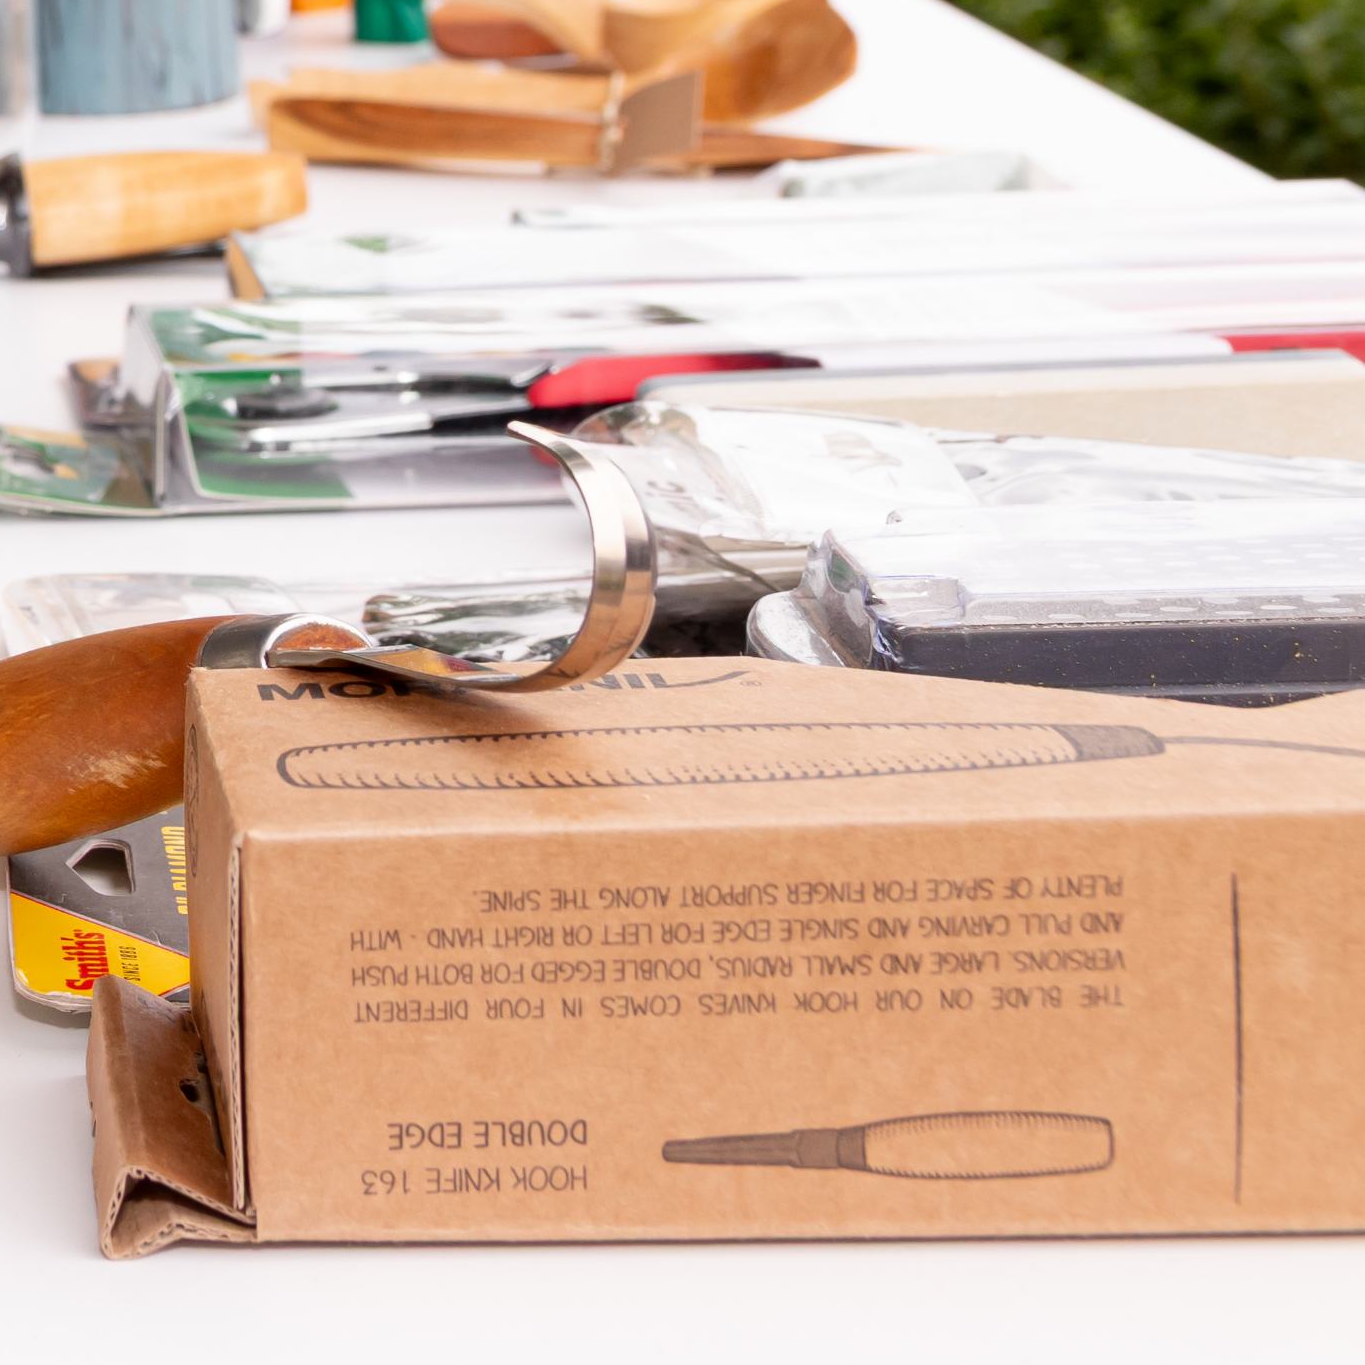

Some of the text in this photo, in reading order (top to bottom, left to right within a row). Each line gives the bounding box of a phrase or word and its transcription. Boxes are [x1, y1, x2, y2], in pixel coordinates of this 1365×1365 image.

[473, 874, 1123, 913] PLENTY OF SPACE FOR FINGER SUPPORT ALONG THE SPINE.
[600, 923, 653, 946] LEFT
[660, 922, 705, 945] FOR
[713, 919, 771, 944] EDGE
[780, 917, 860, 942] SINGLE
[867, 917, 910, 940] AND
[918, 914, 1011, 937] CARVING
[1019, 913, 1072, 935] PULL
[1080, 911, 1124, 934] AND
[350, 928, 404, 952] WITH
[426, 927, 484, 951] HAND
[492, 926, 554, 950] RIGHT
[562, 924, 593, 947] OR
[414, 963, 473, 986] BOTH
[480, 961, 525, 984] FOR
[531, 959, 606, 983] EGGED
[612, 958, 701, 982] DOUBLE
[709, 954, 793, 978] RADIUS,
[803, 953, 873, 976] SMALL
[879, 953, 922, 976] AND
[933, 951, 1000, 974] LARGE
[351, 964, 409, 988] PUSH
[354, 985, 1123, 1024] THE BLADE ON OUR HOOK KNIVES COMES IN FOUR DIFFERENT
[387, 1119, 588, 1151] DOUBLE EDGE
[360, 1165, 588, 1196] HOOK KNIFE 163
